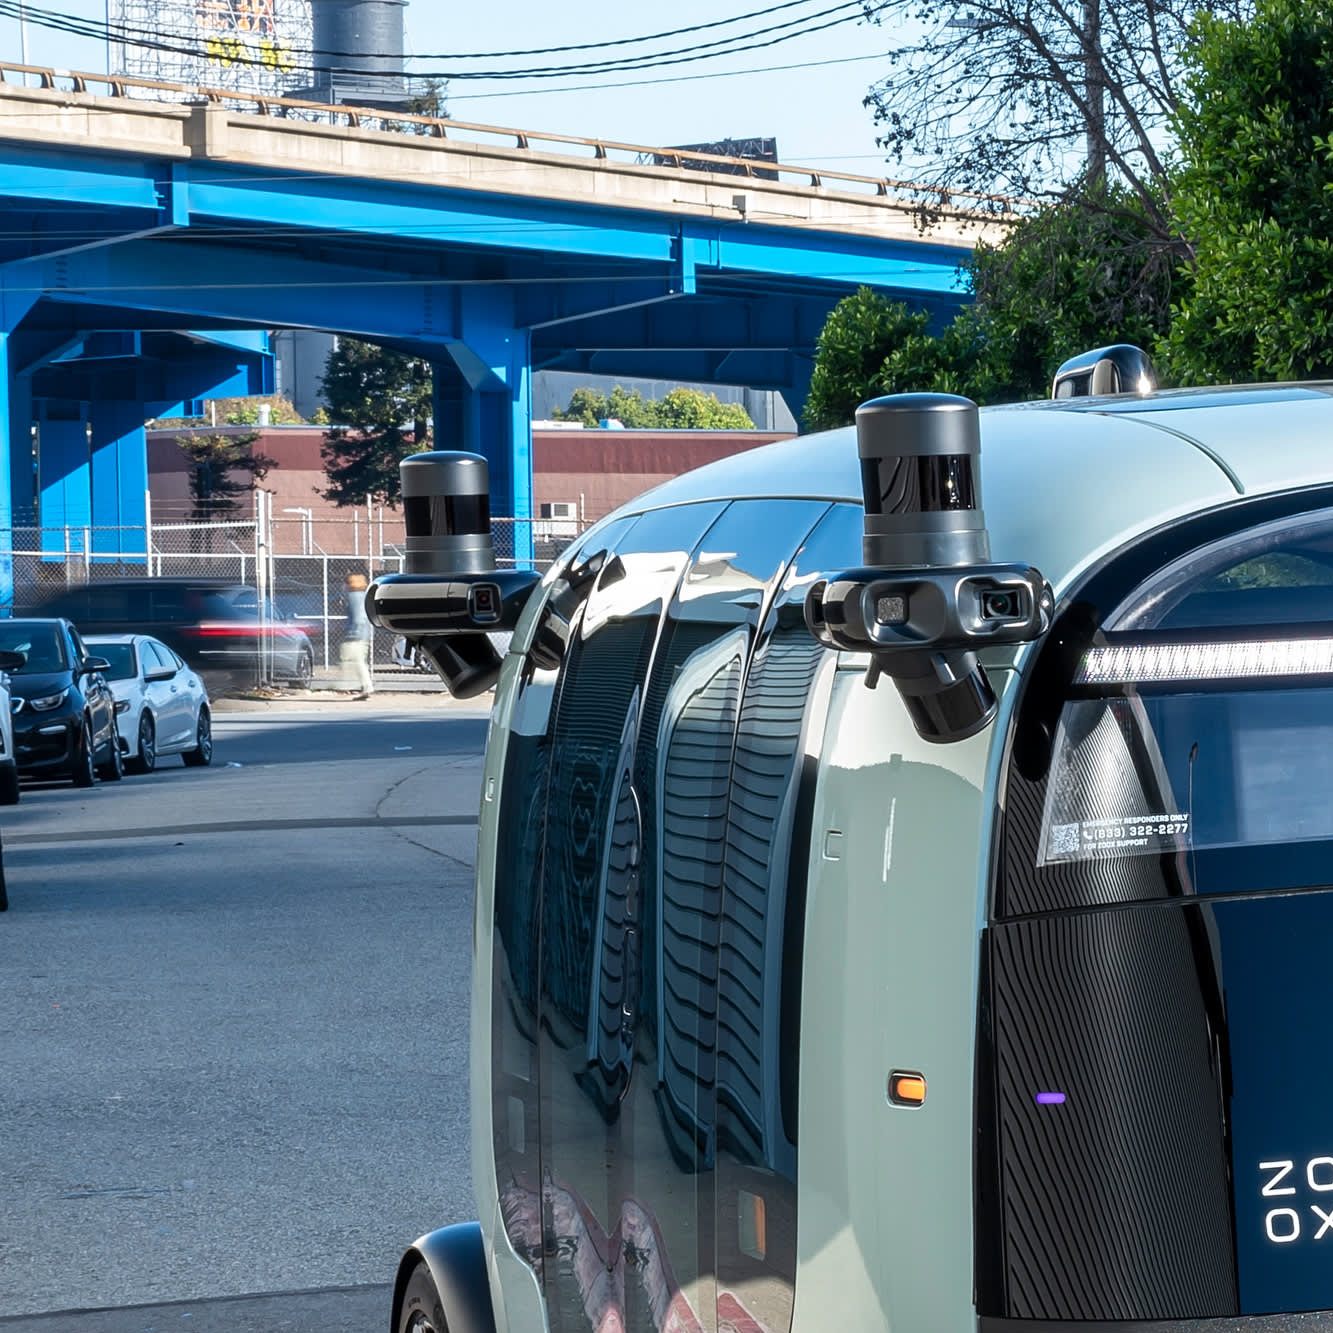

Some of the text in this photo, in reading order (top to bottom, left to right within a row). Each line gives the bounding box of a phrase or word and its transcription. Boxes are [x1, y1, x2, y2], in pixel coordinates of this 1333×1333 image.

[1124, 815, 1169, 824] RESPONDERS
[1129, 823, 1189, 836] 322-2277
[1119, 838, 1149, 847] SUPPORT
